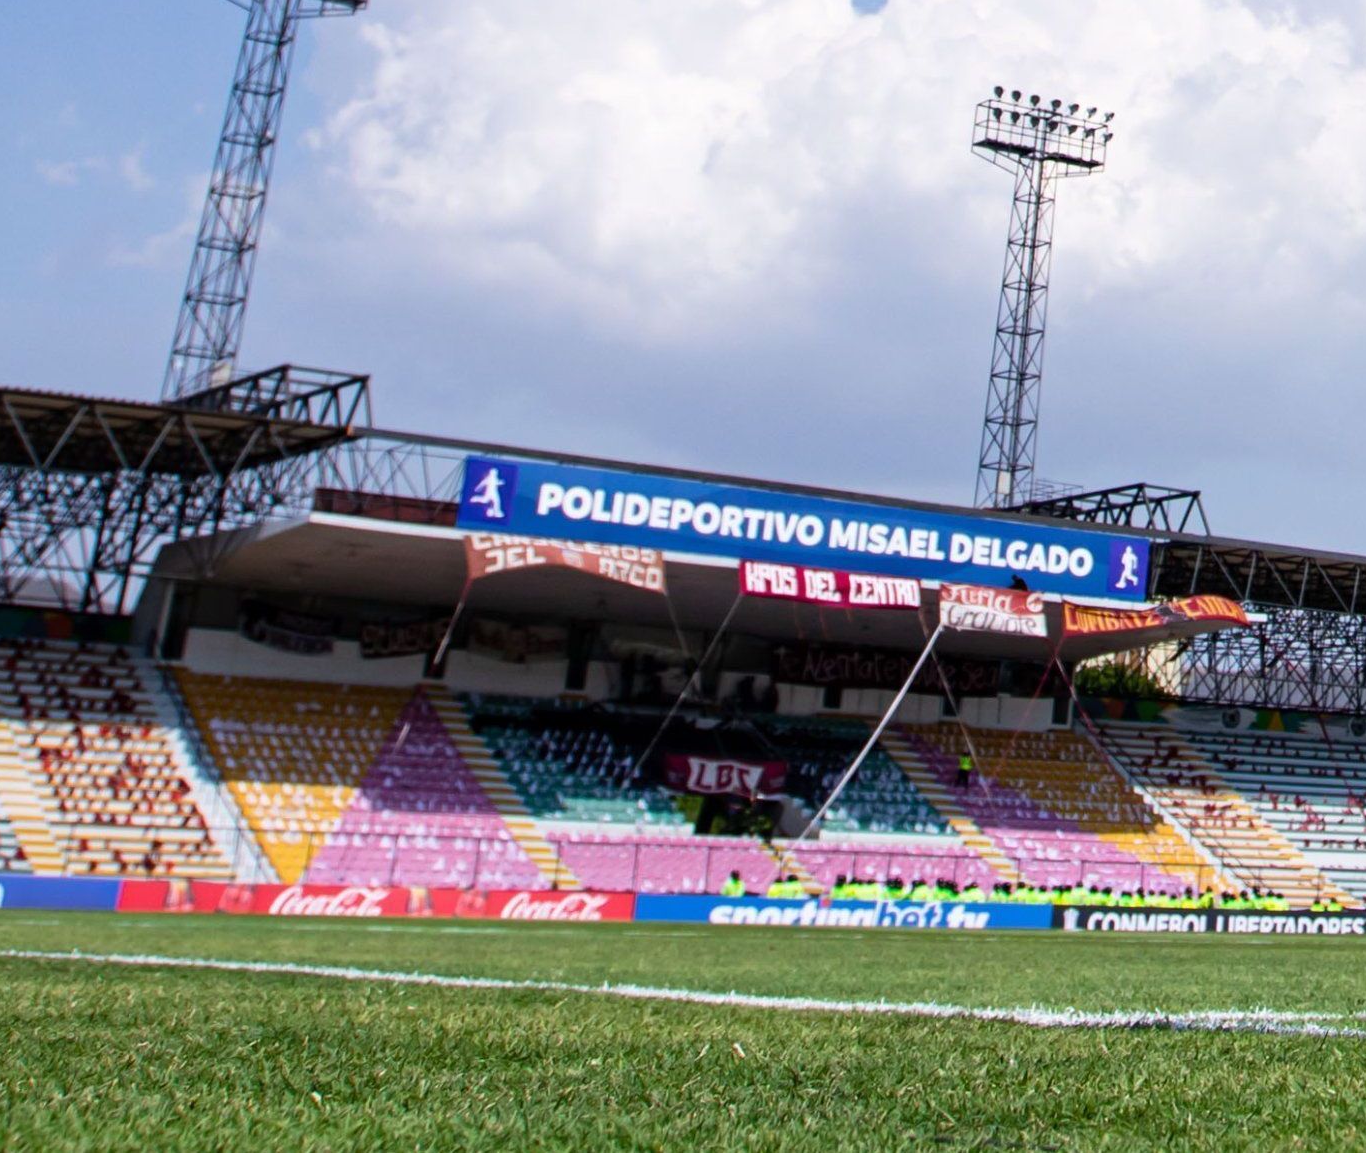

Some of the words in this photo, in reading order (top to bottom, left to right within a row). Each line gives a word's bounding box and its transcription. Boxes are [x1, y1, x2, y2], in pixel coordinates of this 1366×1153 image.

[537, 483, 824, 546] POLIDEPORTIVO
[829, 519, 946, 560] MISAEL
[949, 533, 1094, 577] DELGADO
[803, 569, 841, 602] DEL
[848, 574, 921, 607] CENTRO
